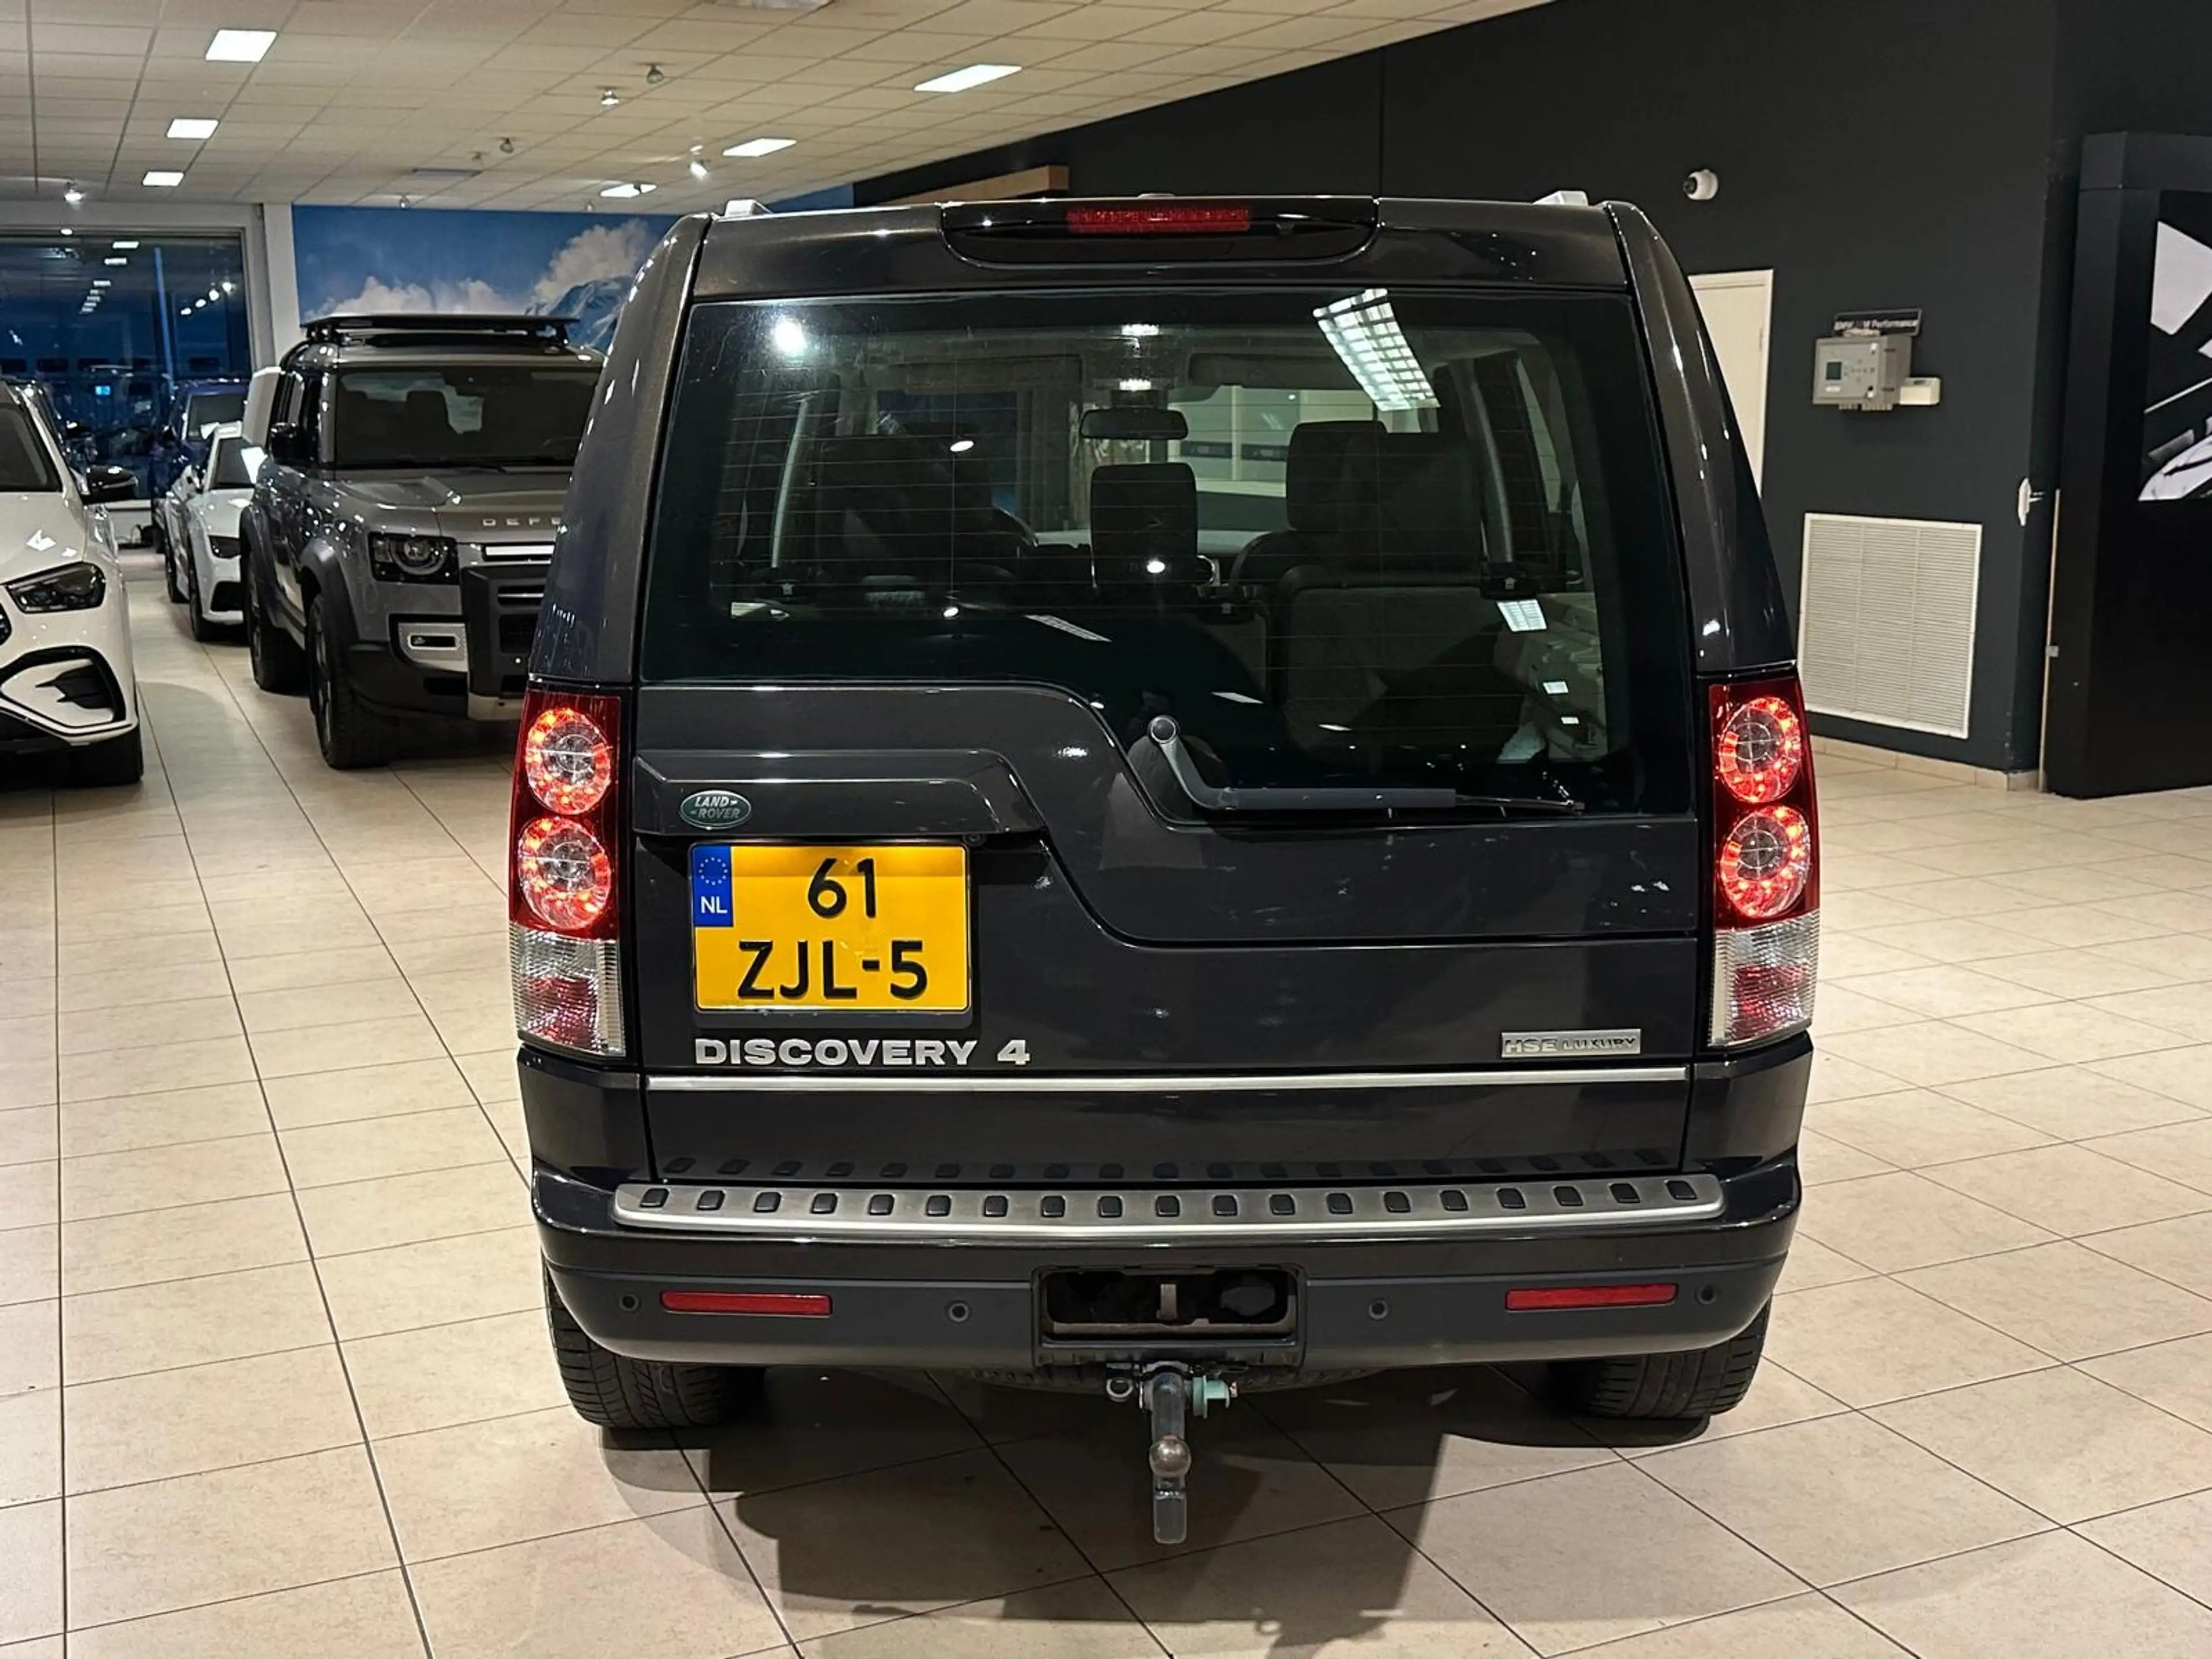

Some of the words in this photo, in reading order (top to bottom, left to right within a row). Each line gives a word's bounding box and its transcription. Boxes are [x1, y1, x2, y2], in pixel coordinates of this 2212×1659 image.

[1872, 319, 1919, 329] Performance
[808, 858, 876, 919] 61
[700, 896, 728, 914] NL
[738, 940, 928, 1001] ZJL-5
[695, 1039, 978, 1066] DISCOVERY
[997, 1039, 1031, 1065] 4
[1505, 1037, 1558, 1054] HSE
[1563, 1036, 1636, 1051] LUXURY
